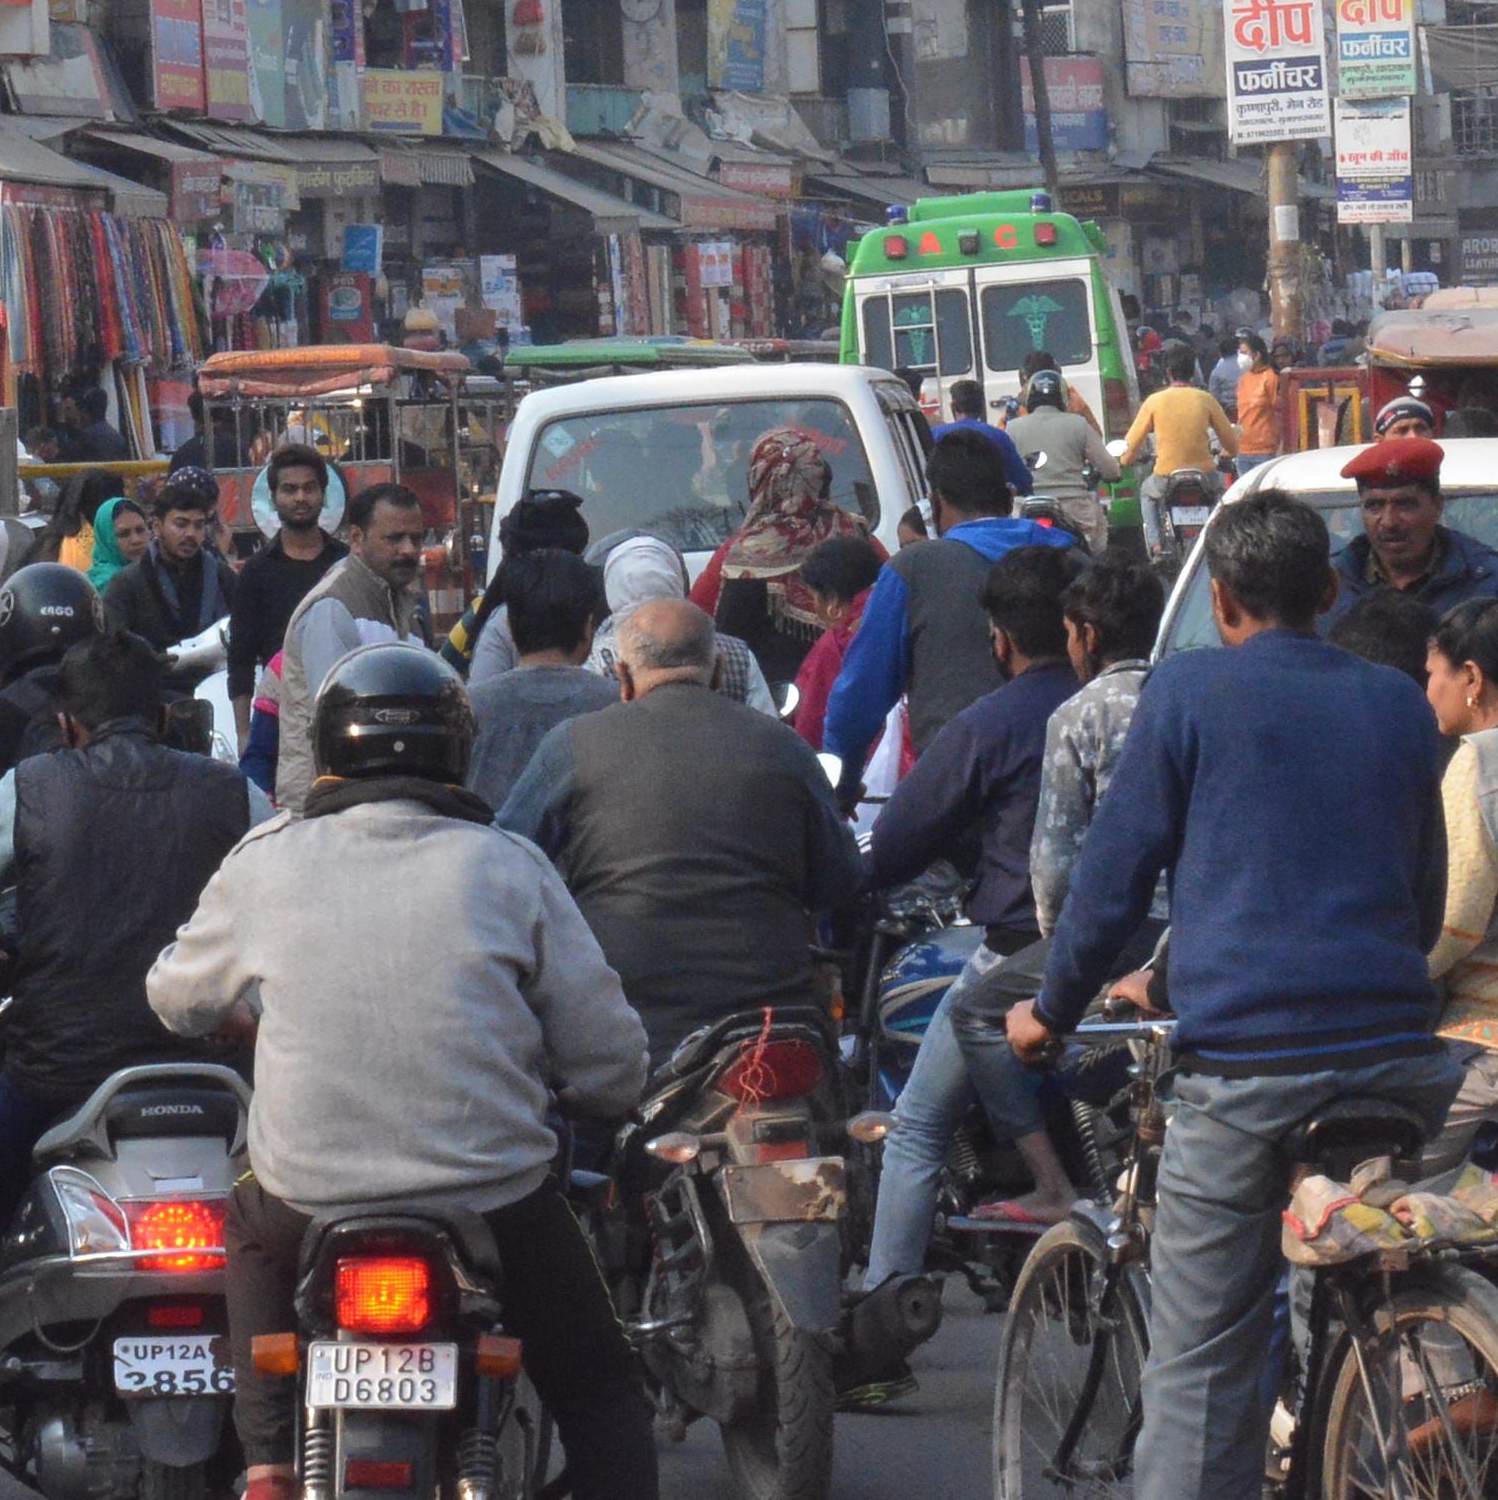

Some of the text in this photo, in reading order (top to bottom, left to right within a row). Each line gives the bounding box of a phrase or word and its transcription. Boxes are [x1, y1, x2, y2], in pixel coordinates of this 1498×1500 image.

[1341, 35, 1407, 57] फर्नीचर
[1237, 63, 1319, 92] फर्नीचर
[917, 225, 1018, 256] A C
[140, 1104, 204, 1117] HONDA
[333, 1377, 438, 1404] D6803
